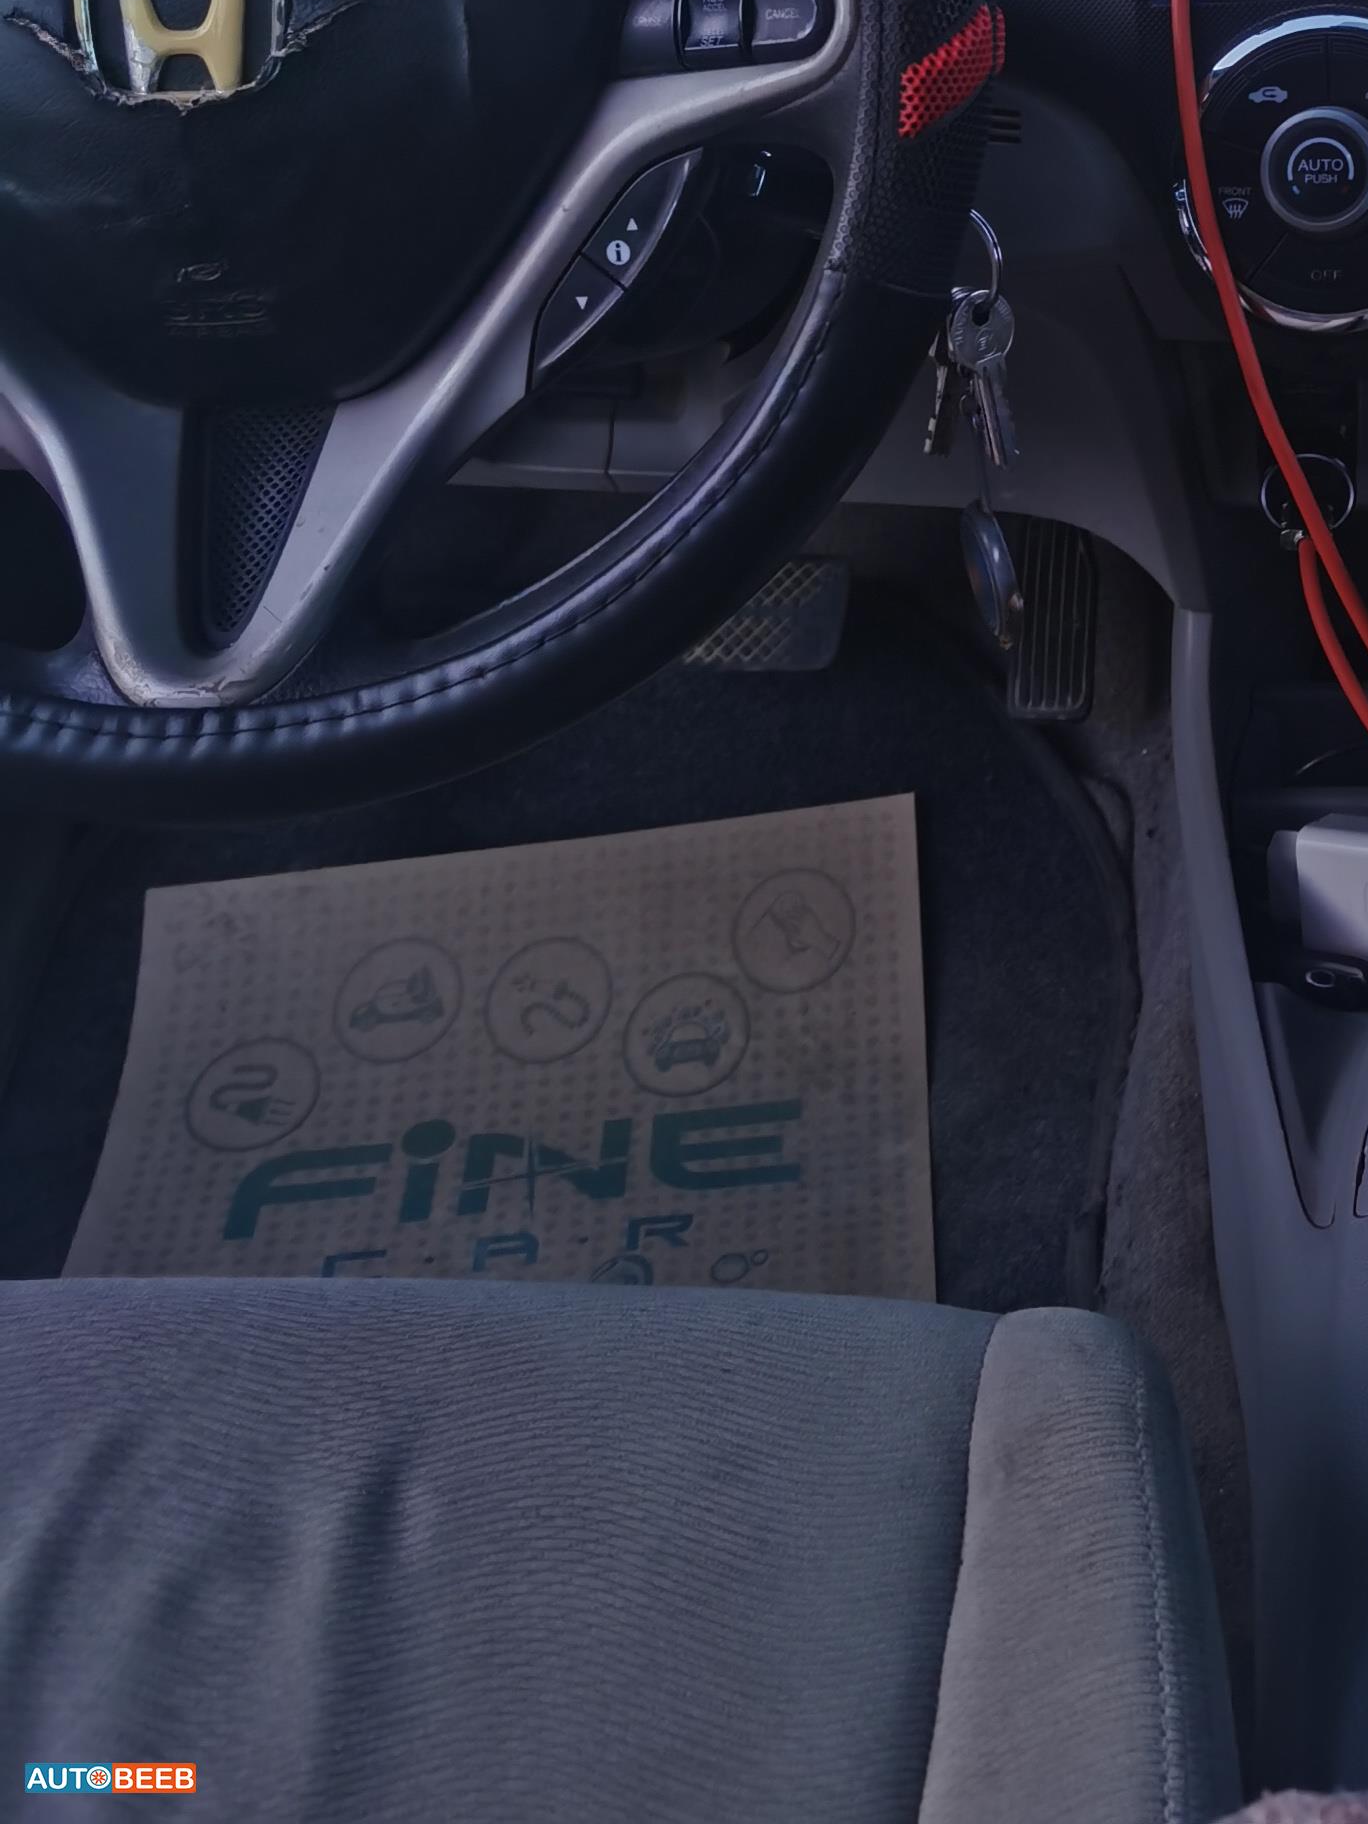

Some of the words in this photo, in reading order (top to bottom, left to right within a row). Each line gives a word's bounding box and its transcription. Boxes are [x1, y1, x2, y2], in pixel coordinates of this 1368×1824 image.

[1298, 158, 1344, 173] AUTO
[1304, 174, 1338, 184] PUSH
[1218, 186, 1253, 197] FRONT
